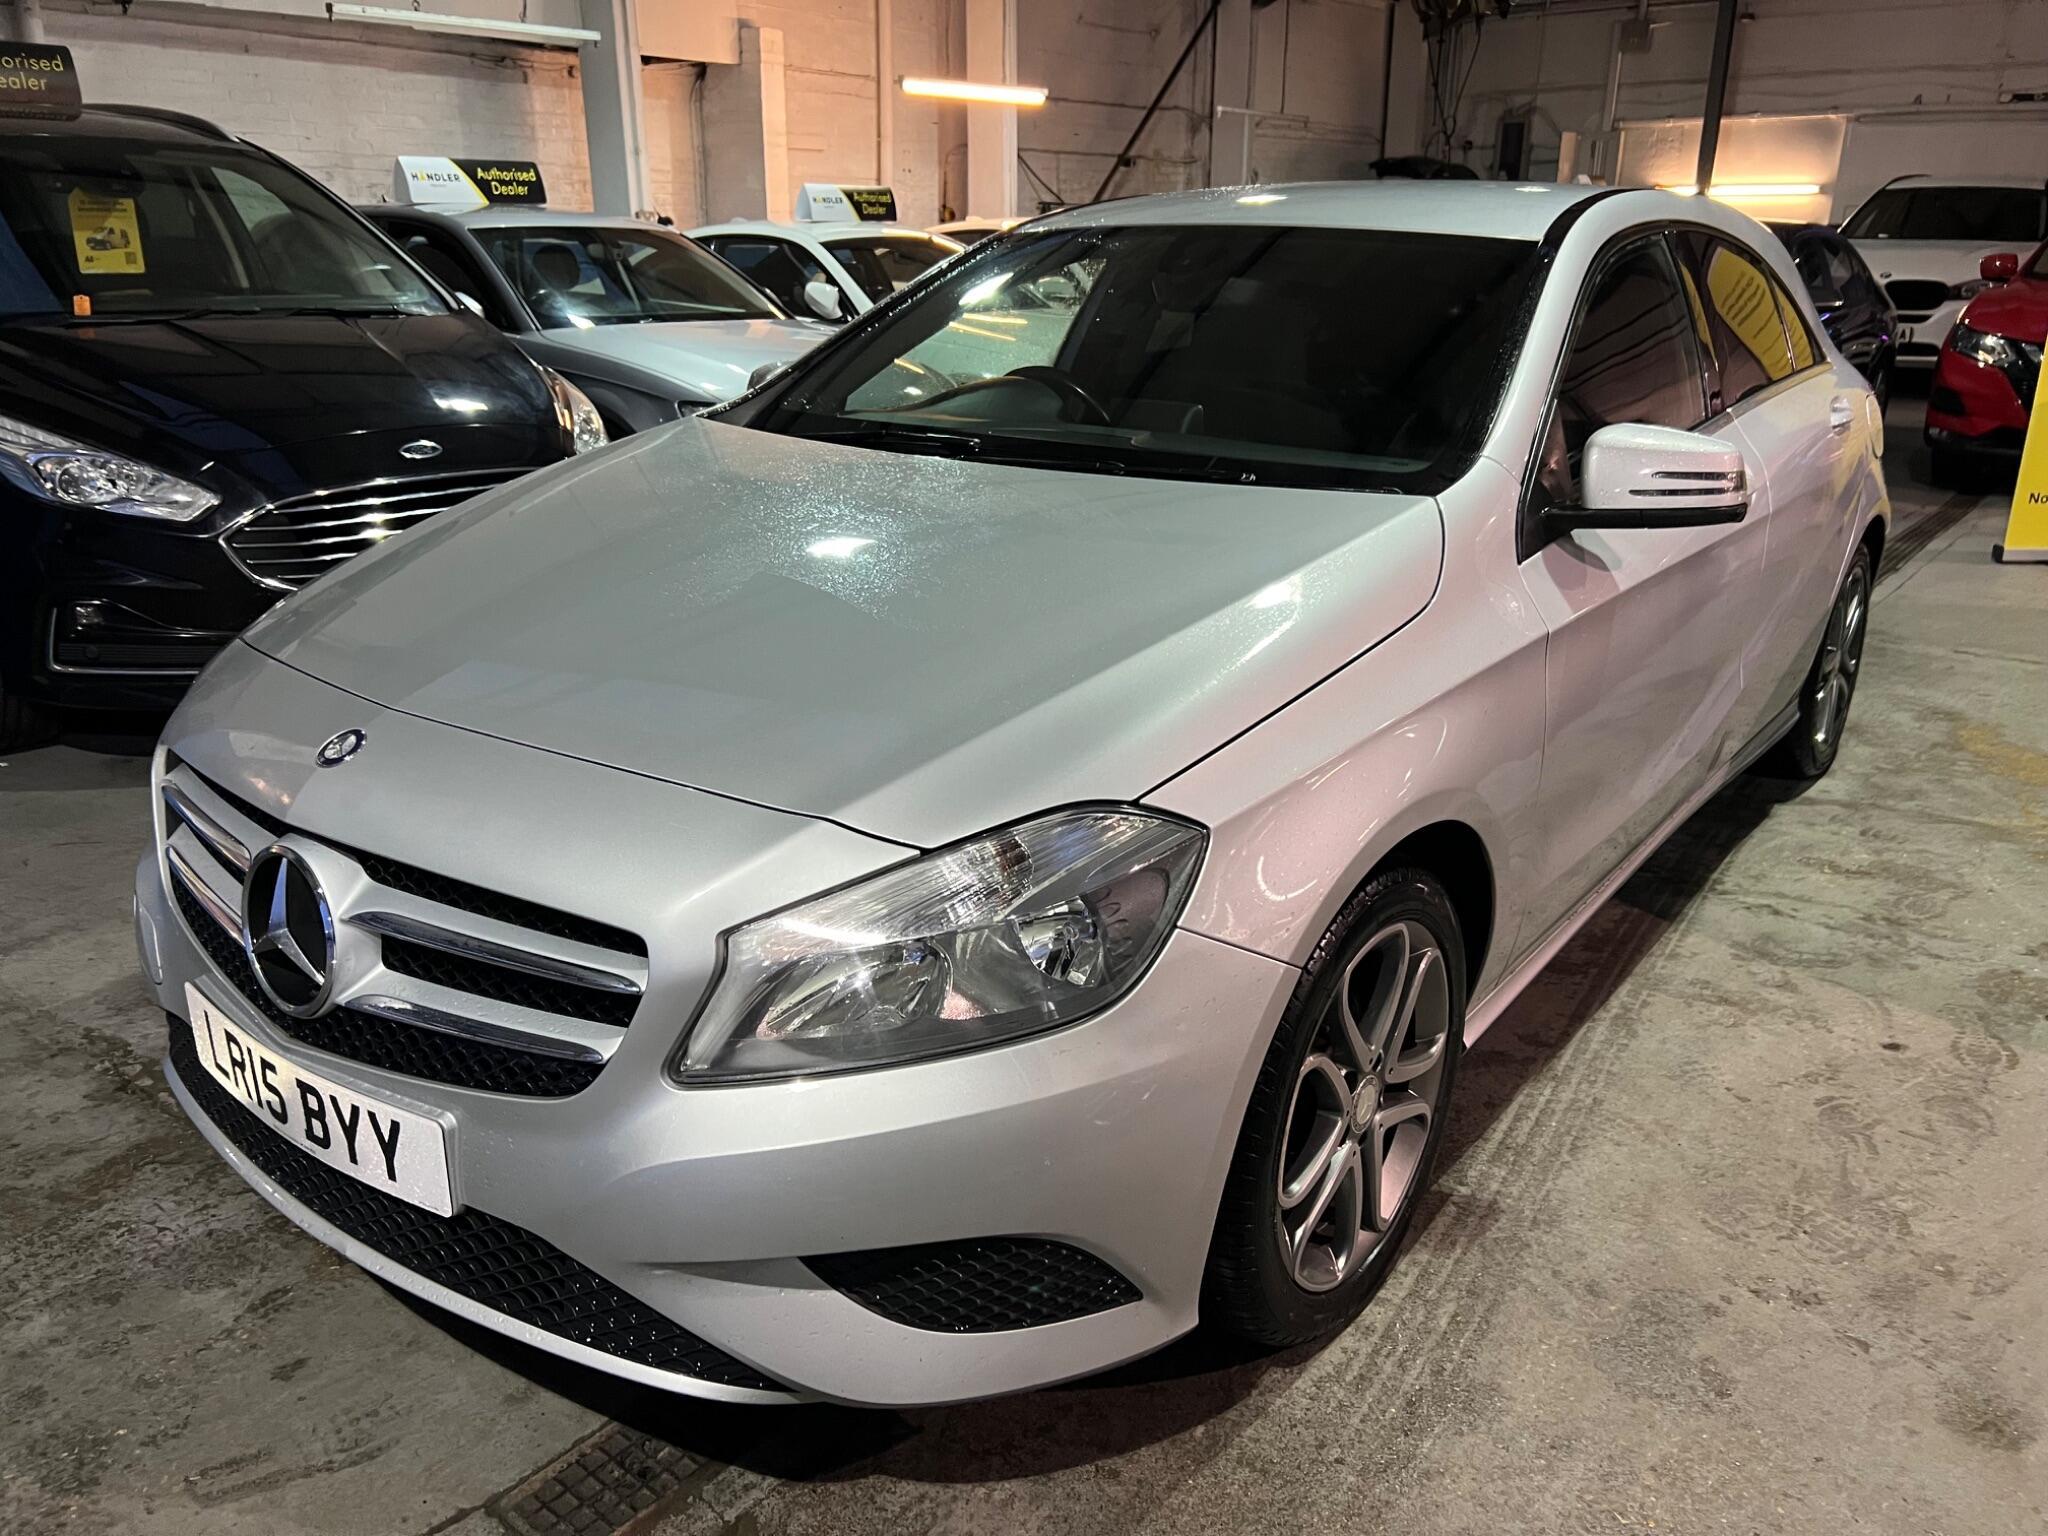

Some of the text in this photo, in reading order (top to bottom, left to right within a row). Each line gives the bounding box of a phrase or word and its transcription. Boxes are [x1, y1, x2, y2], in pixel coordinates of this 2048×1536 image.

[477, 166, 537, 182] Authorised
[491, 182, 529, 195] Dealer
[862, 203, 886, 214] Dealer
[203, 1009, 401, 1183] LR15 BYY
